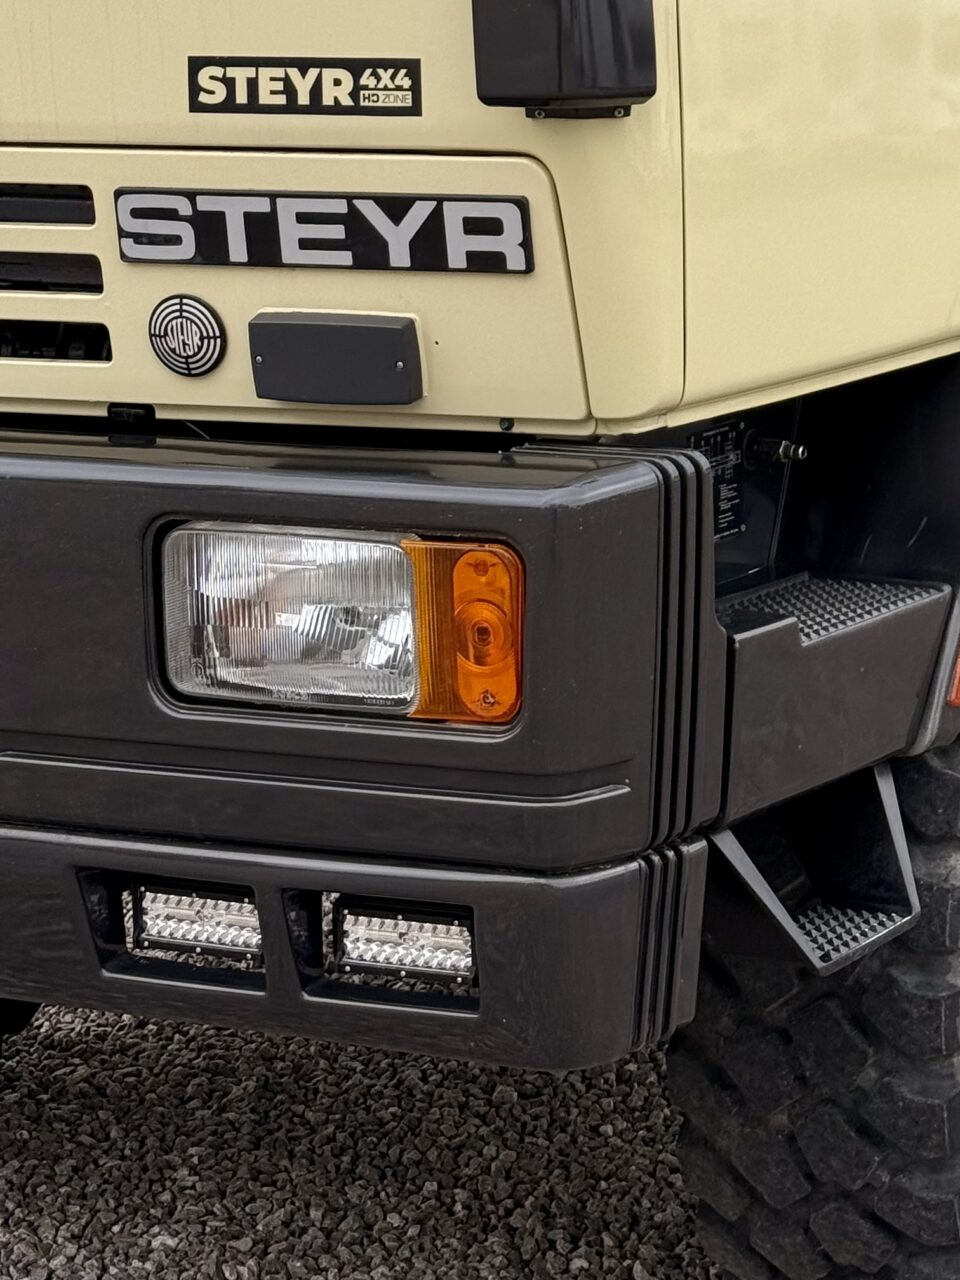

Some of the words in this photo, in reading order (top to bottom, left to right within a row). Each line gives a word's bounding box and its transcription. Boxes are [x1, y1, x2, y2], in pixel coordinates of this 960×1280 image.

[196, 66, 354, 106] STEYR
[359, 67, 413, 90] 4X4
[381, 93, 411, 105] ZONE
[117, 194, 526, 270] STEYR
[166, 318, 201, 356] STEYR
